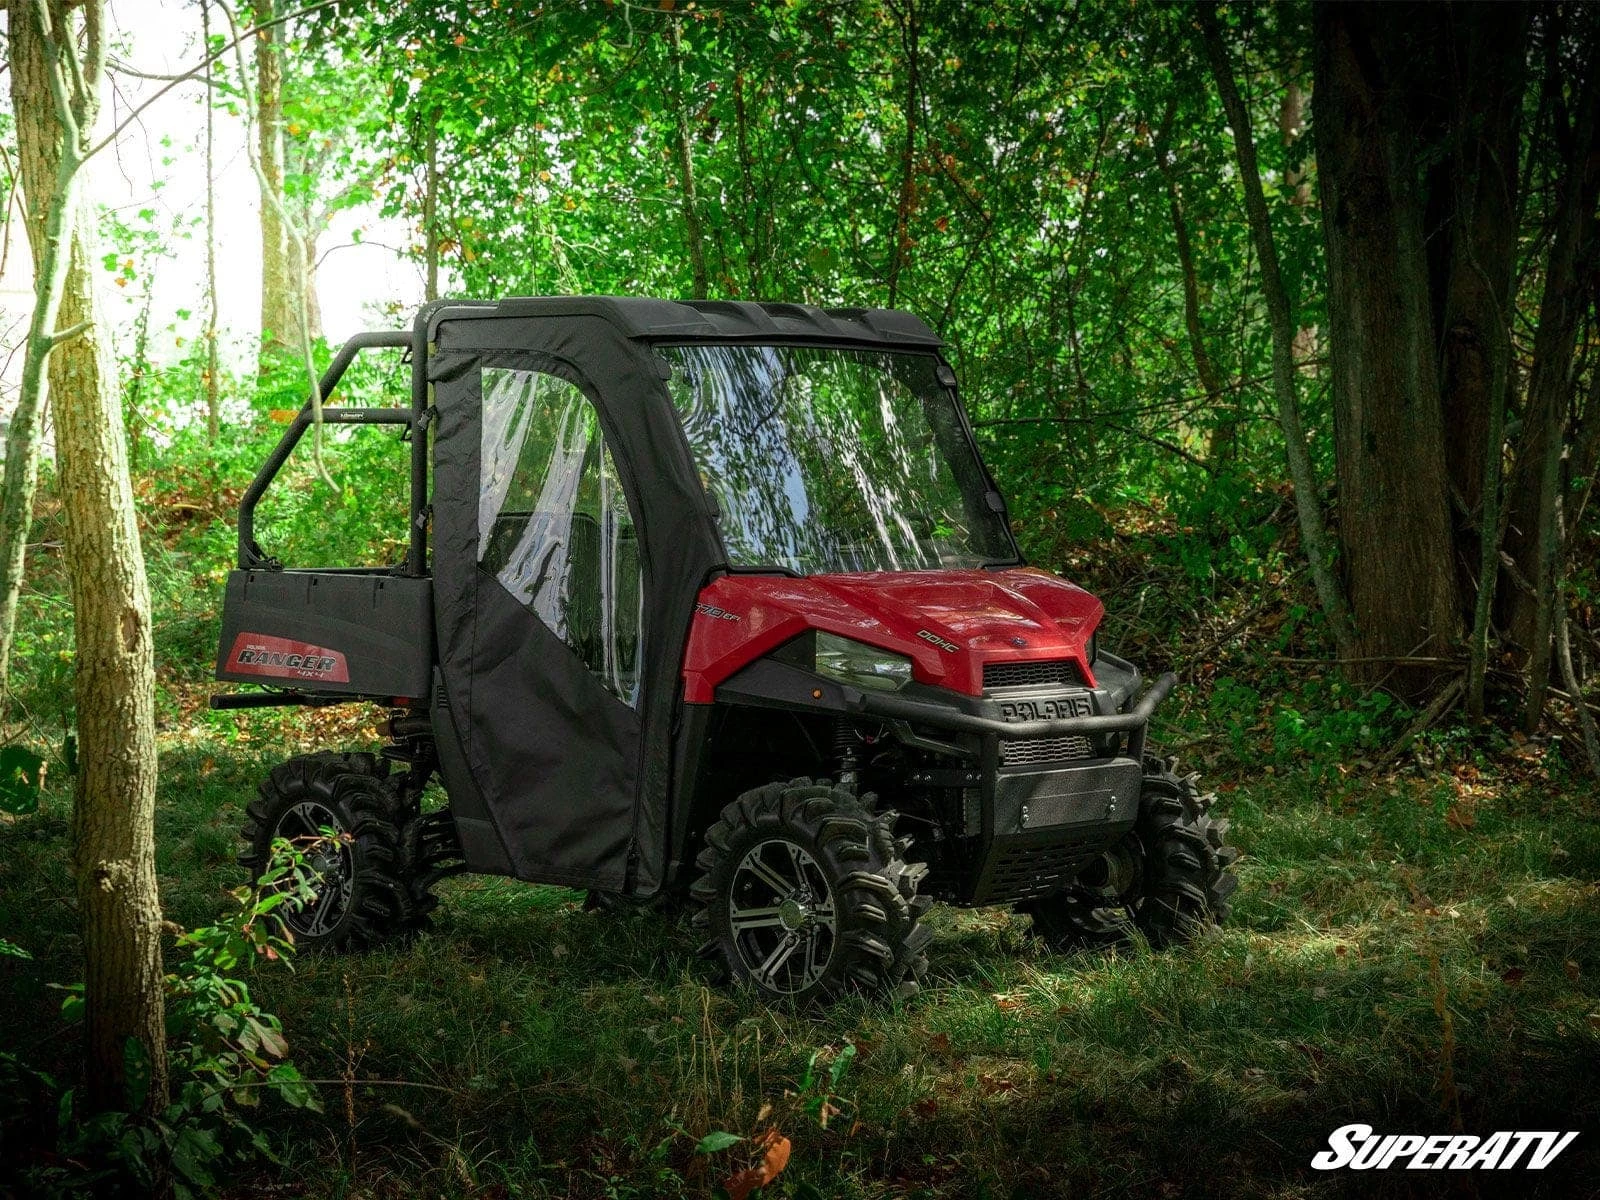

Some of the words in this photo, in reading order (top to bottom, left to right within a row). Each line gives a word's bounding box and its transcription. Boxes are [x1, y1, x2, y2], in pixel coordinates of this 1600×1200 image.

[916, 629, 960, 653] DOHC
[237, 649, 336, 672] RANGER
[1000, 697, 1091, 722] POLARIS
